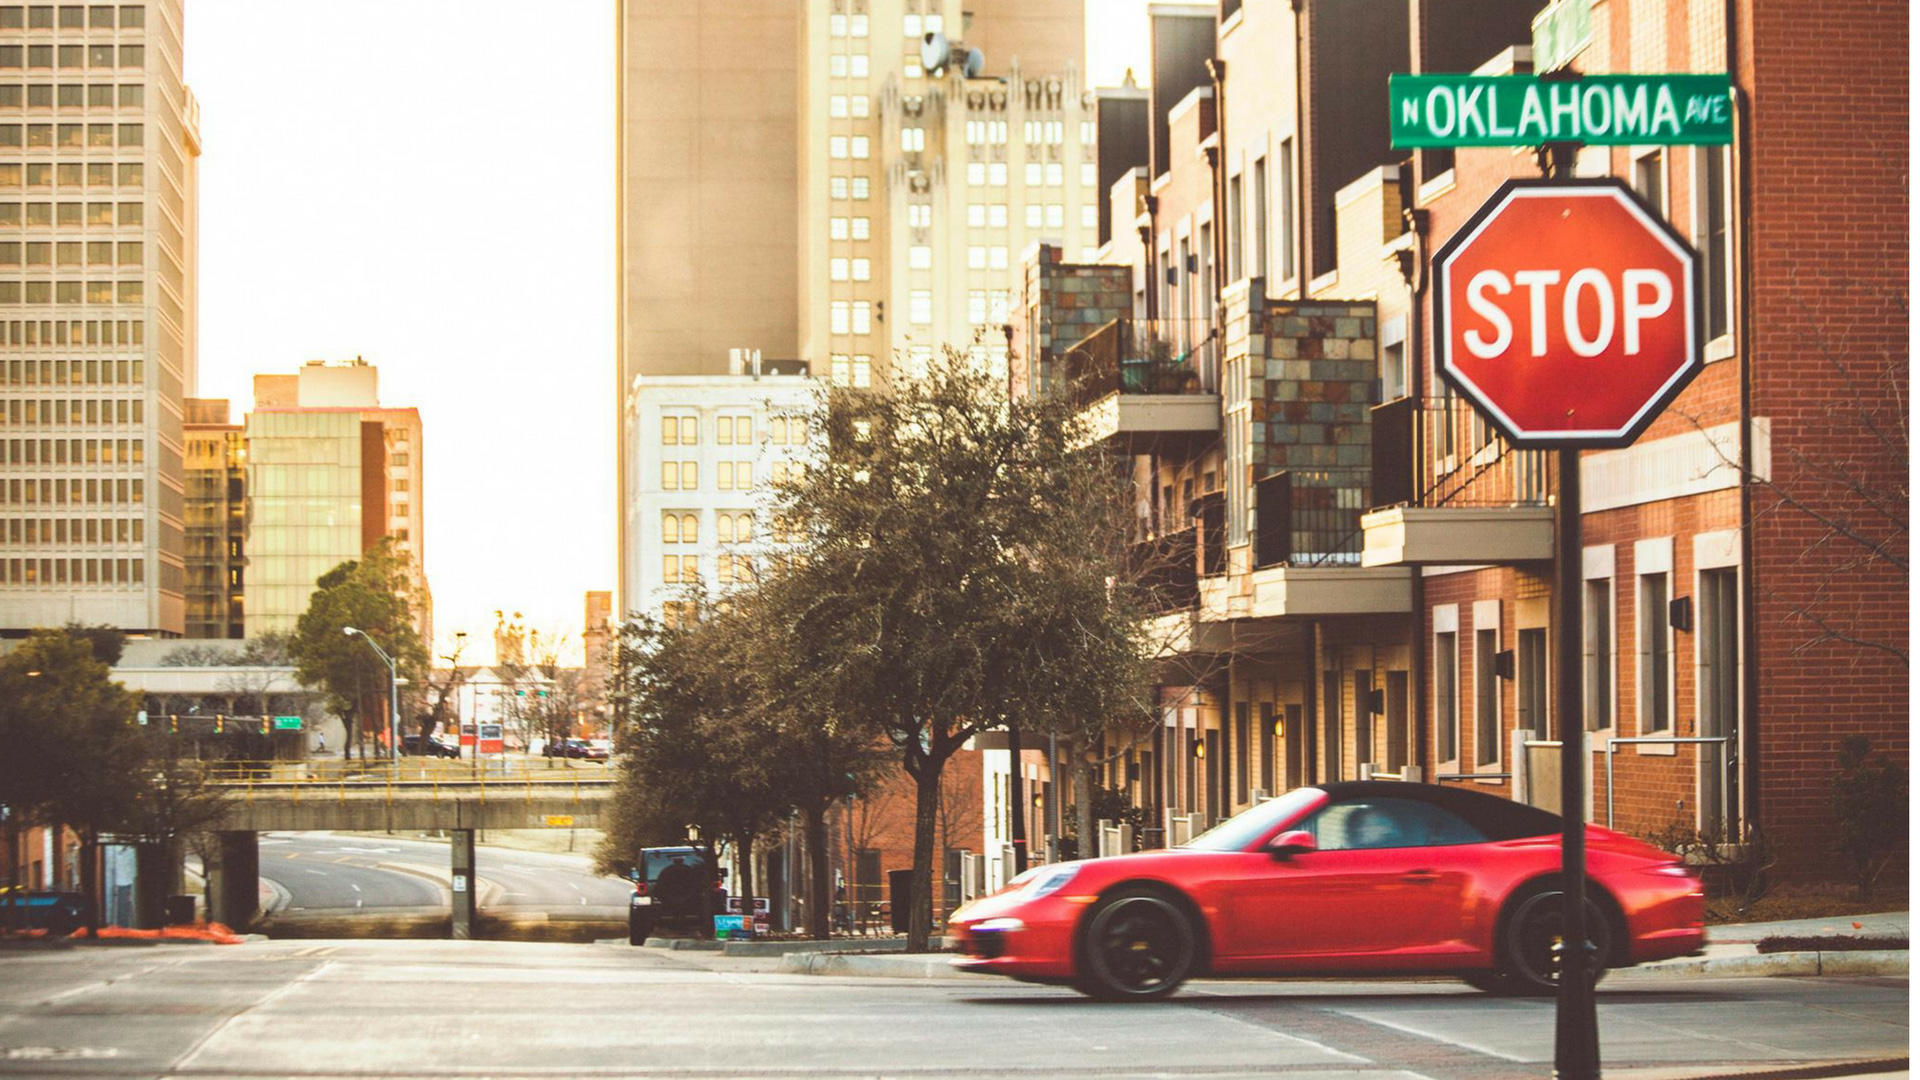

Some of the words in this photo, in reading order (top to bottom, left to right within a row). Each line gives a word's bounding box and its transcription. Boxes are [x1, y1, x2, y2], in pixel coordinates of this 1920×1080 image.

[1402, 97, 1418, 127] N
[1426, 84, 1681, 138] OKLAHOMA
[1683, 94, 1728, 125] AVE
[1463, 268, 1673, 359] STOP
